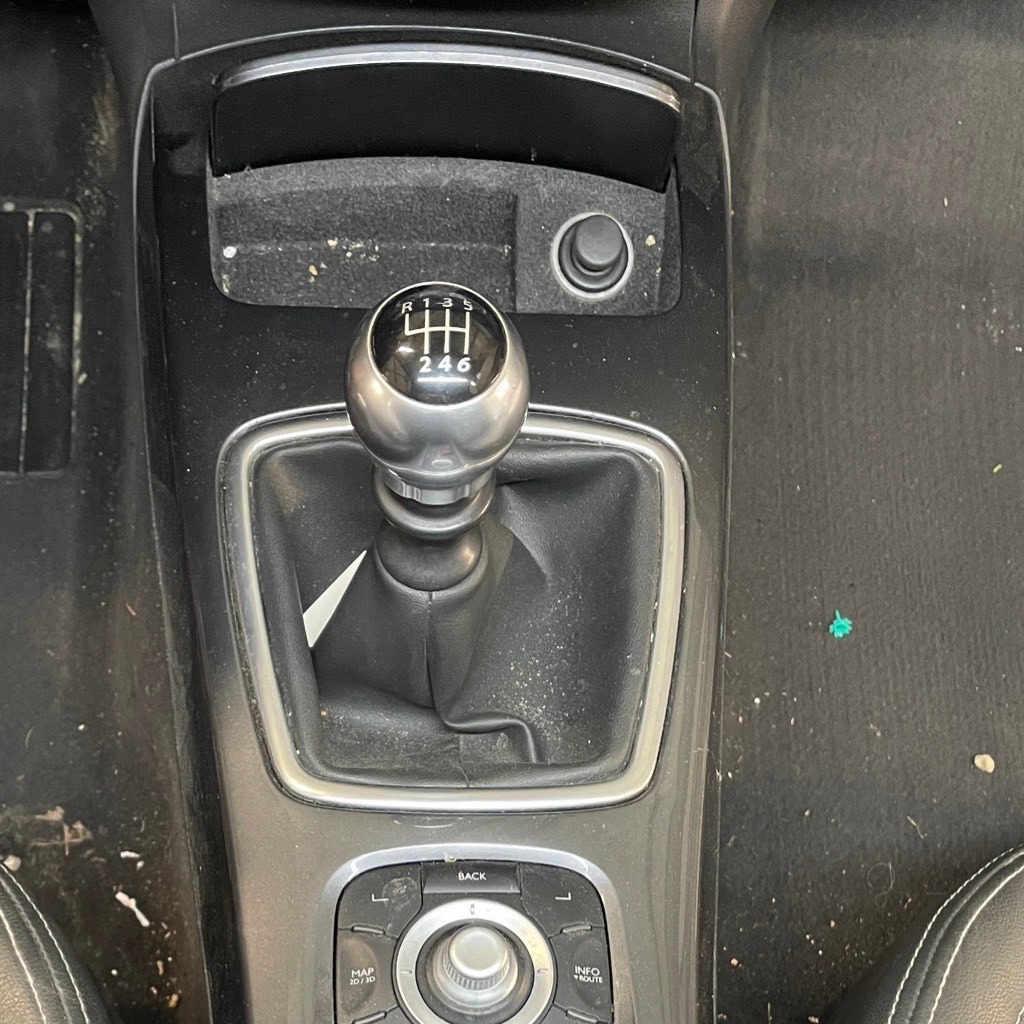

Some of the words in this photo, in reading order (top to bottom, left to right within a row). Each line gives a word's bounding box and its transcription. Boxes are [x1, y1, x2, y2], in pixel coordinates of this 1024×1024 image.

[401, 301, 413, 314] R
[422, 298, 430, 308] 1
[442, 297, 453, 308] 3
[463, 300, 473, 311] 5
[419, 357, 432, 373] 2
[438, 355, 452, 372] 4
[457, 357, 471, 372] 6
[458, 872, 487, 881] BACK
[351, 967, 375, 978] MAP
[574, 966, 600, 976] INFO
